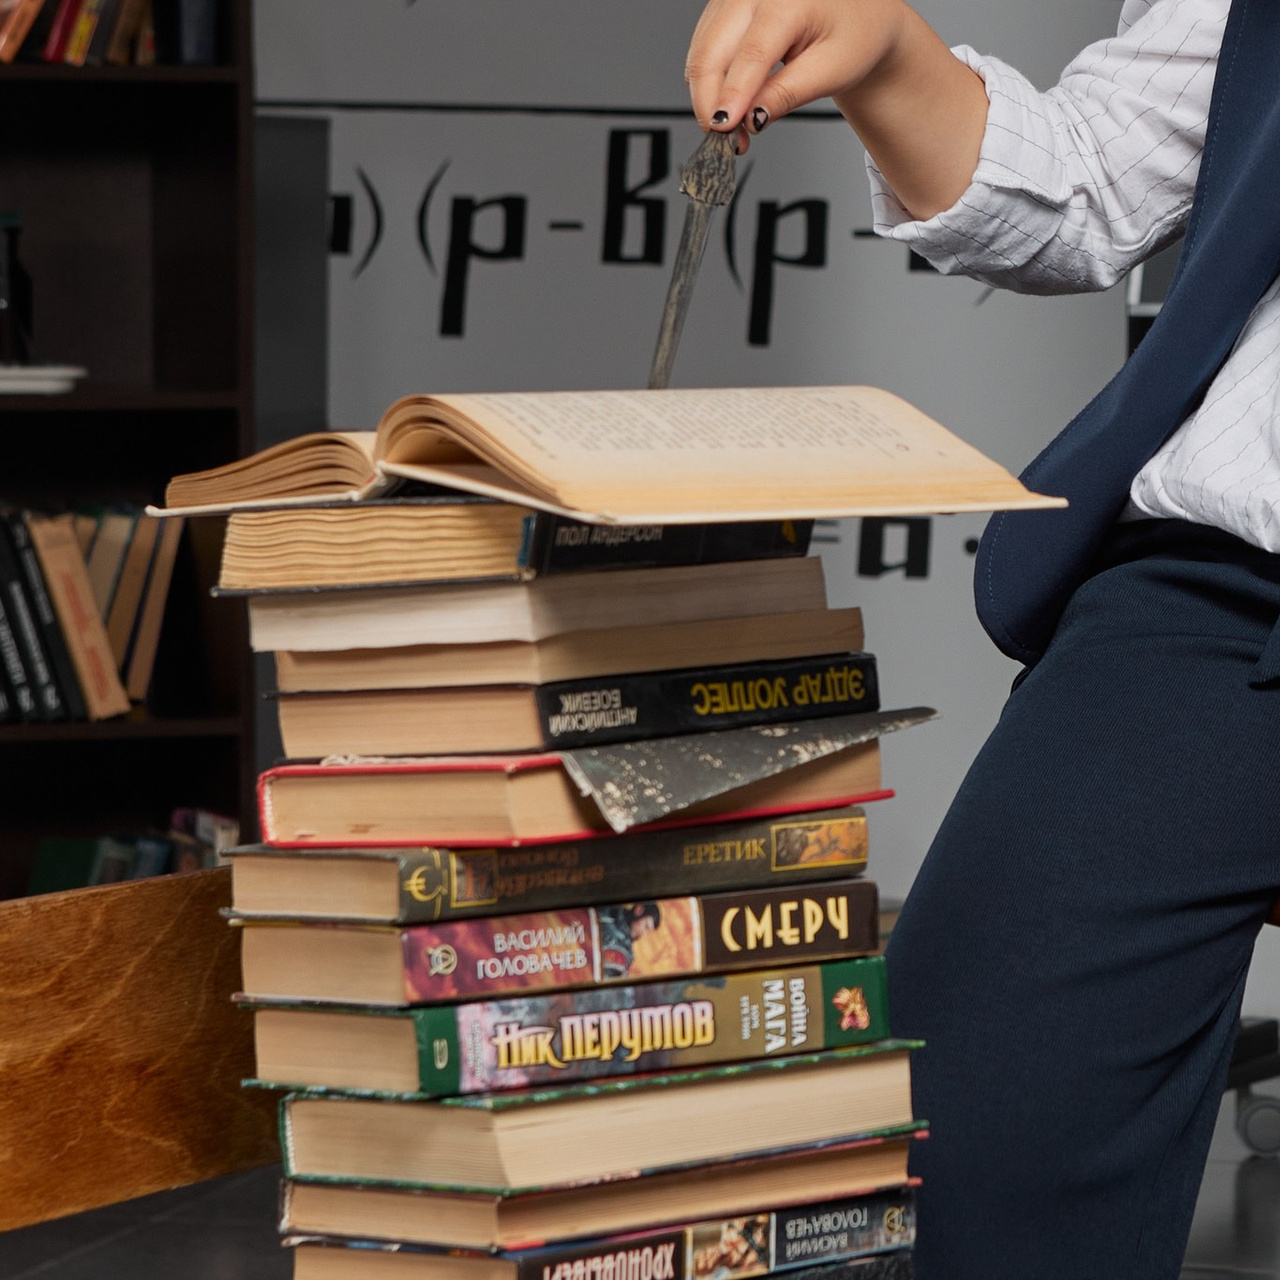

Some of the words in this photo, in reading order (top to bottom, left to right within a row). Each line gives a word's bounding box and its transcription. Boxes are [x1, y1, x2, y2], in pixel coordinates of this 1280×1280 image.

[559, 689, 621, 712] БОЕВИК
[690, 677, 789, 716] УОЛЛЕС
[794, 665, 867, 705] ЭДГАР
[683, 836, 767, 865] ЕРЕТИК
[494, 922, 586, 952] ВАСИЛИЙ
[720, 895, 851, 953] СМЕРЧ
[476, 948, 588, 980] ГОЛОВАЧЕВ
[763, 978, 785, 1054] МАГА
[785, 977, 806, 1047] ВОЙНА
[560, 1000, 716, 1062] ПЕРУМОВ
[785, 1206, 868, 1241] ГОЛОВАЧЕВ
[785, 1231, 850, 1261] ВАСИЛИЙ
